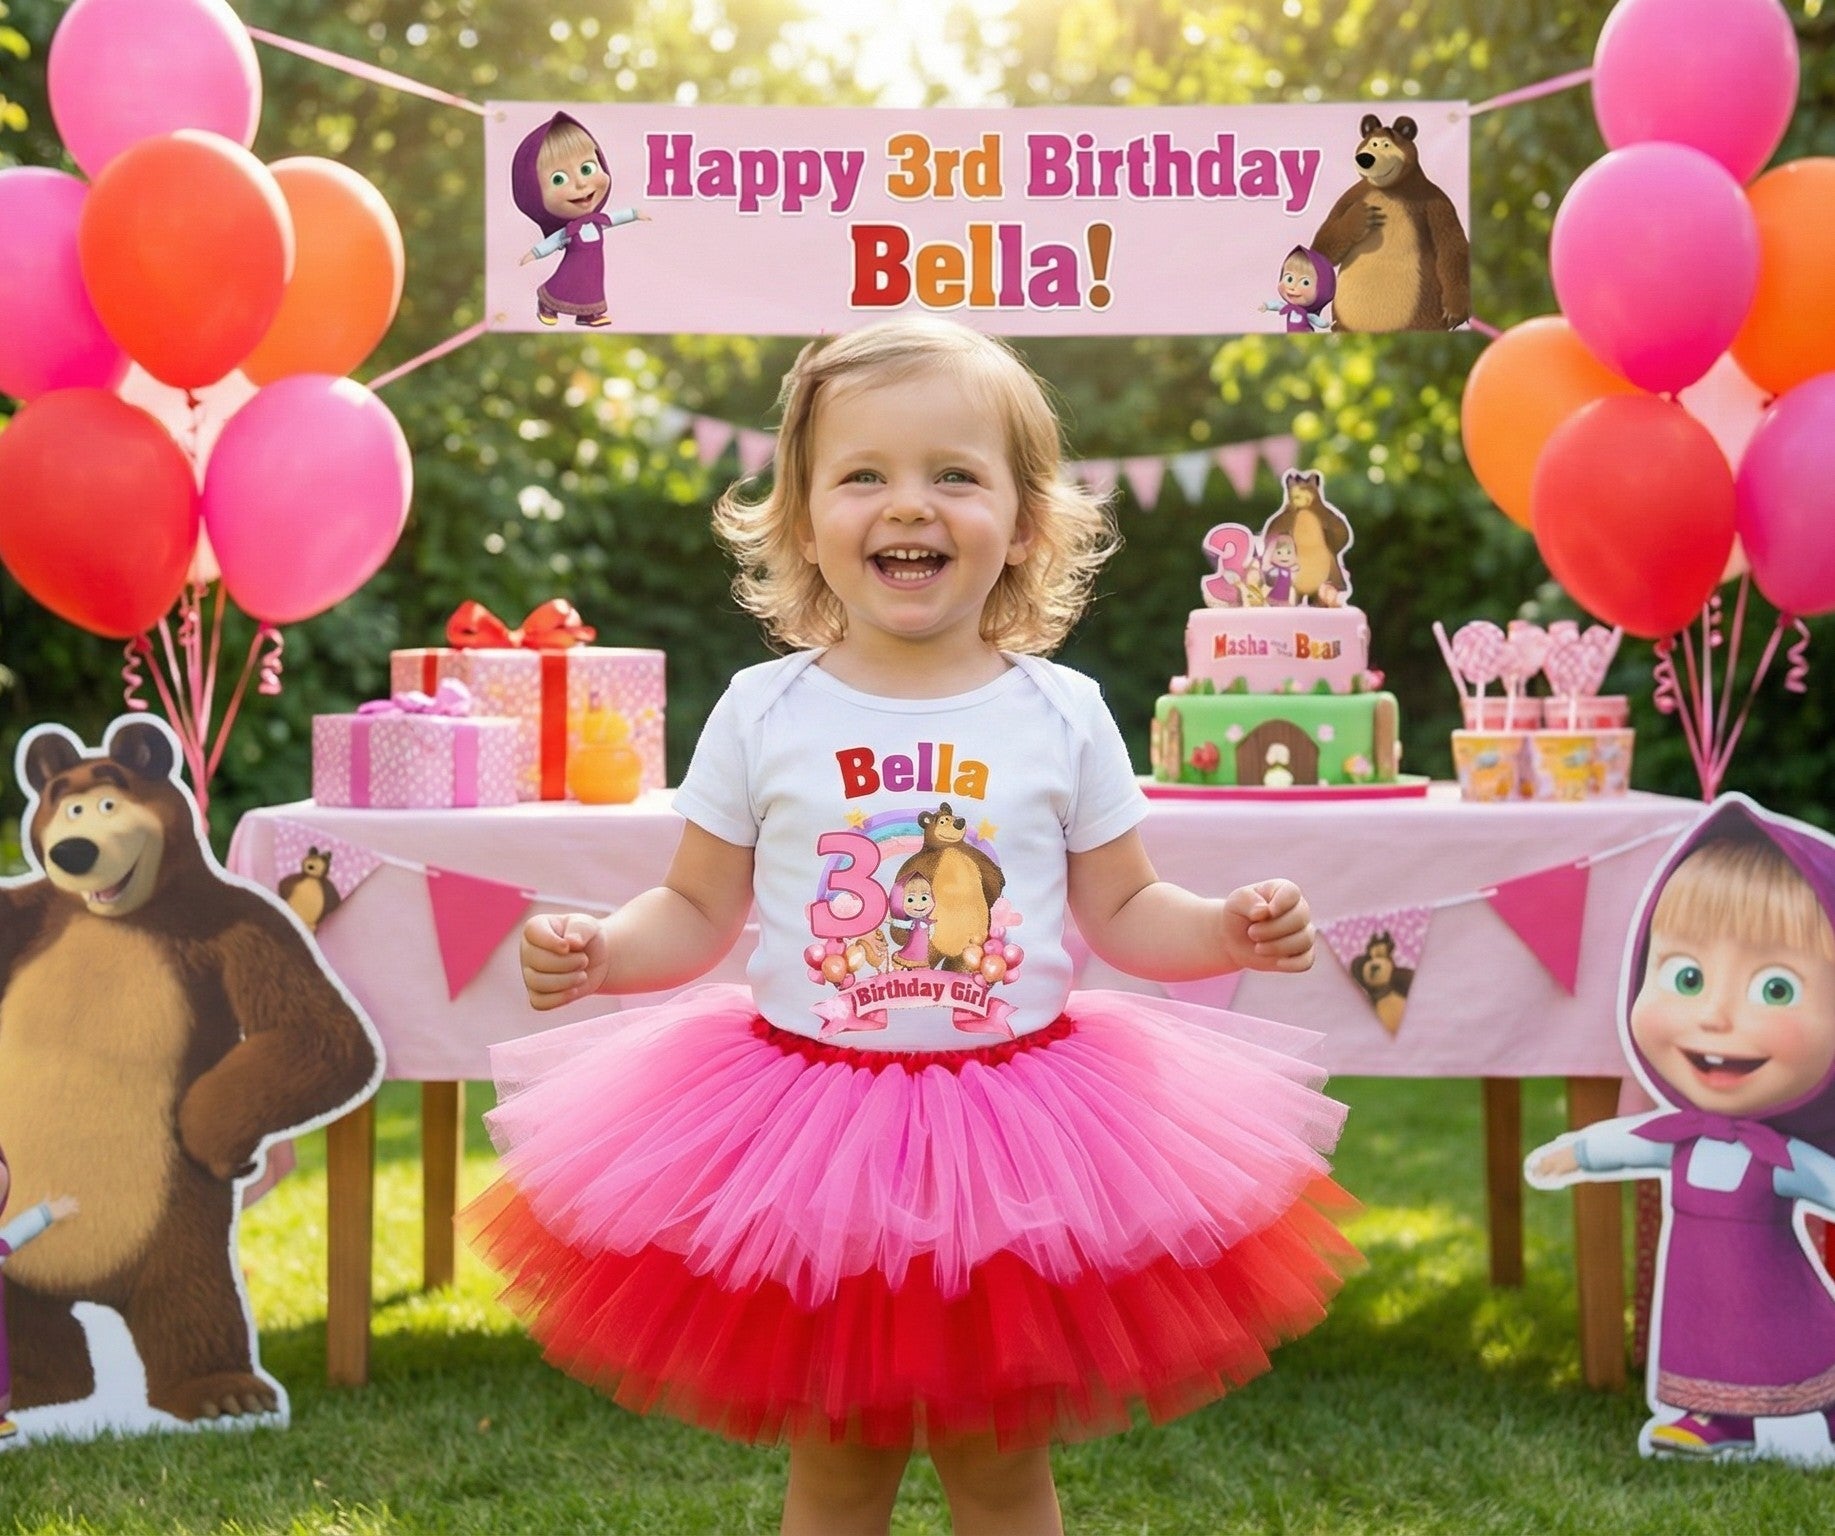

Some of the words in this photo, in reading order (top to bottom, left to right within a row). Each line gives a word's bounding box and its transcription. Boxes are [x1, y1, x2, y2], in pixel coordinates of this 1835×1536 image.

[646, 134, 864, 212] Happy
[888, 134, 1002, 198] 3rd
[1027, 134, 1320, 212] Birthday
[850, 223, 1112, 307] Bella!
[835, 742, 990, 799] Bella
[810, 831, 889, 939] 3
[855, 977, 946, 1007] Birthday
[950, 981, 991, 1008] Girl
